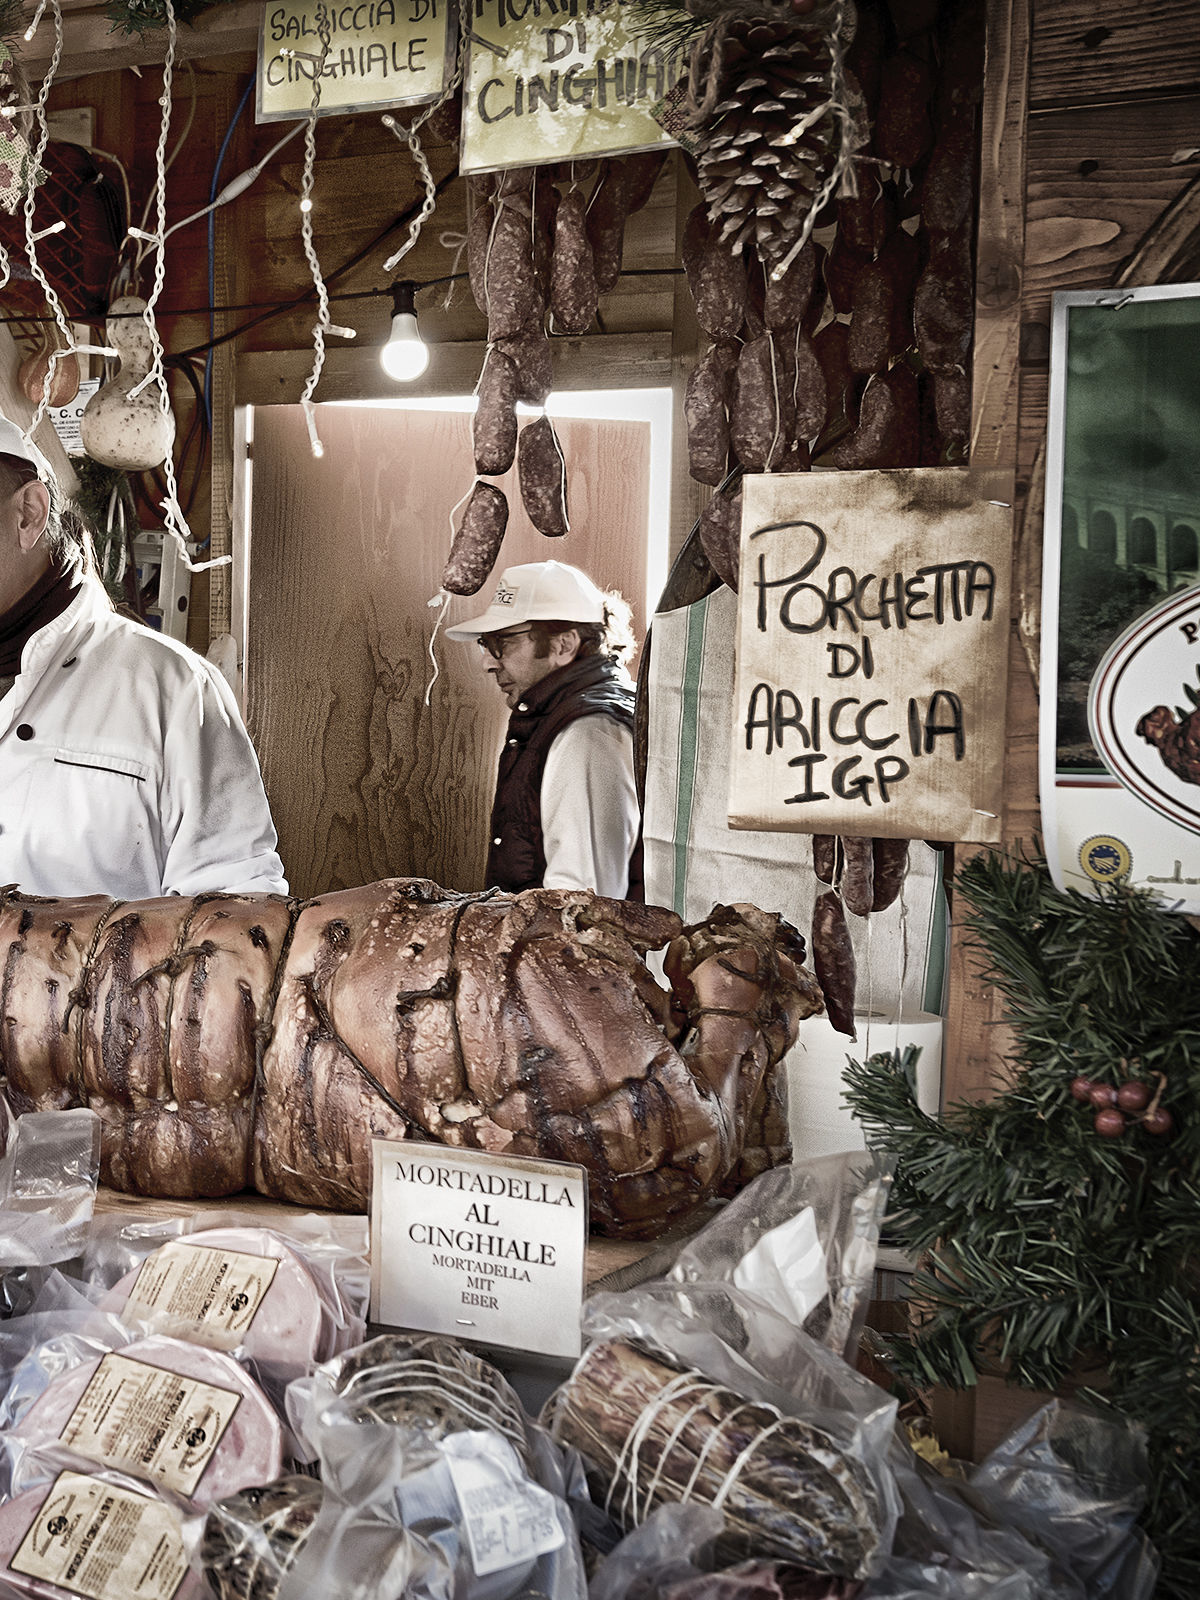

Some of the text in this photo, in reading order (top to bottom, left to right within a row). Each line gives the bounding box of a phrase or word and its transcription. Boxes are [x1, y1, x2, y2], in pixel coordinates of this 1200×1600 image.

[267, 38, 427, 86] CINGHIALE
[541, 22, 587, 63] DI
[749, 520, 997, 634] PORCHETTA
[827, 636, 874, 679] DI
[744, 683, 966, 761] ARICCIA
[784, 753, 910, 806] IGP
[395, 1161, 576, 1208] MORTADELLA
[464, 1202, 500, 1227] AL
[408, 1223, 557, 1267] CINGHIALE
[432, 1253, 532, 1283] MORTADELLA
[466, 1275, 496, 1292] MIT
[461, 1291, 500, 1310] EBER
[171, 1415, 194, 1451] NORCIA
[59, 1511, 83, 1548] NORCIA
